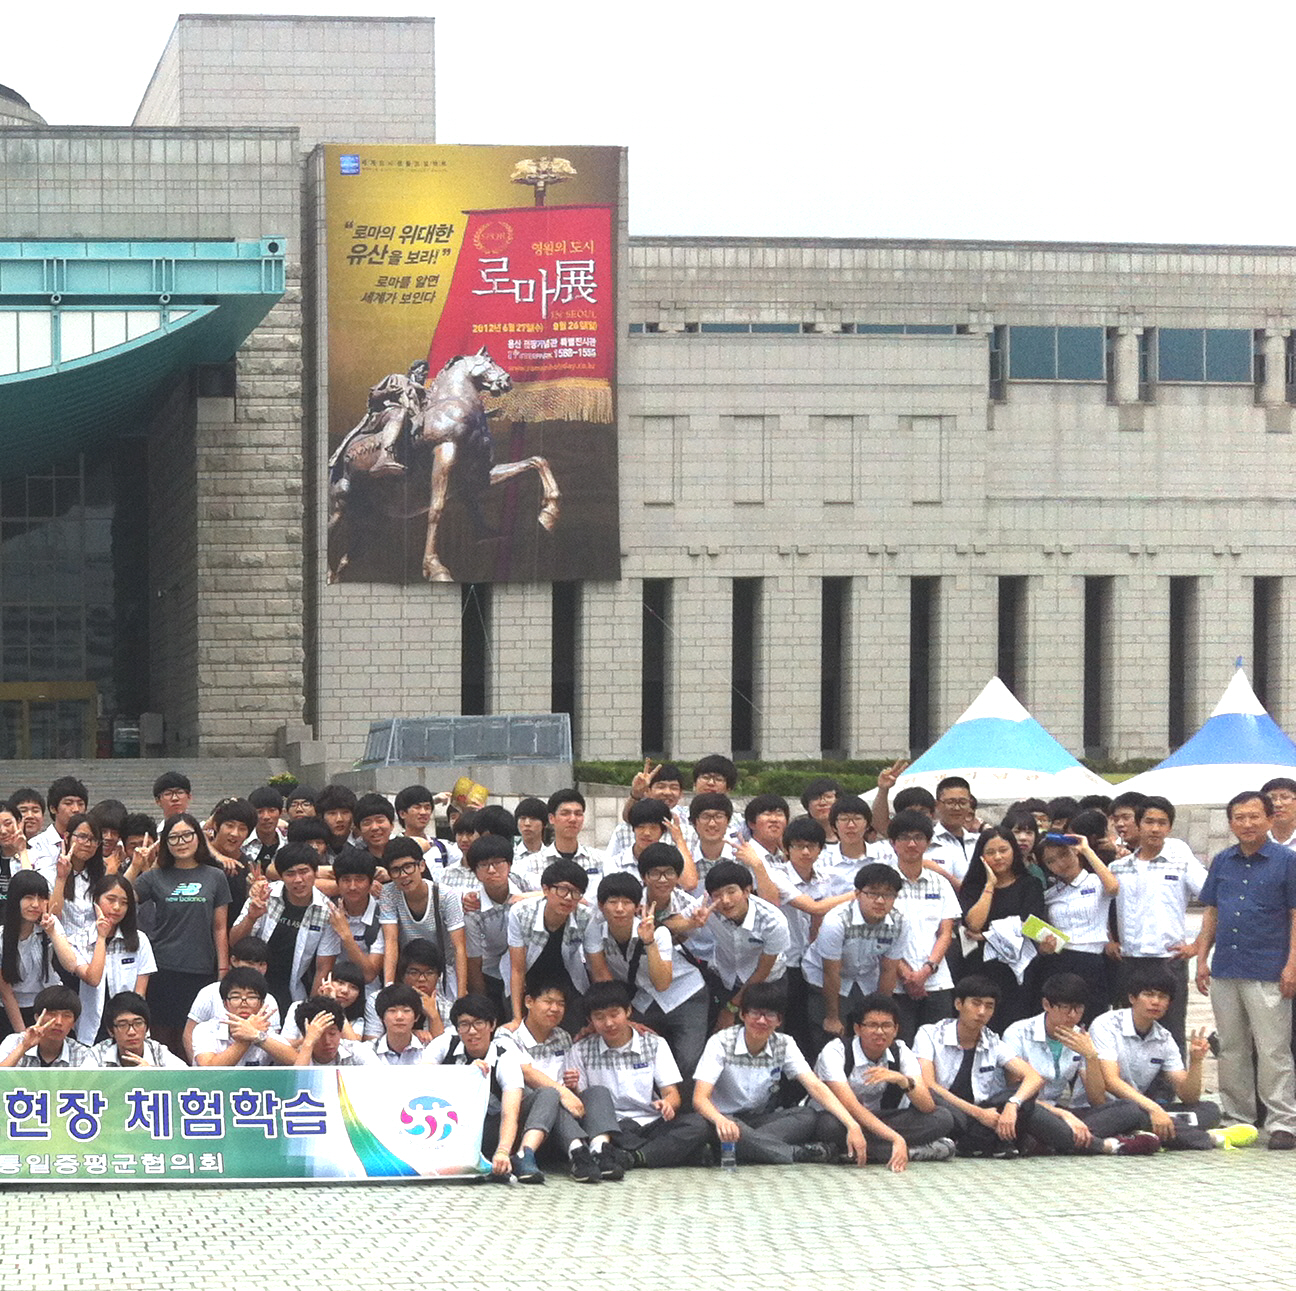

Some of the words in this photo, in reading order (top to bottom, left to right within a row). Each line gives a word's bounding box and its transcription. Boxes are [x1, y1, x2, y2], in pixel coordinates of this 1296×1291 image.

[398, 223, 454, 244] 위대한
[346, 244, 403, 266] 유산을
[569, 240, 594, 254] 도시
[399, 290, 436, 304] 보인다
[472, 257, 598, 320] 로마展
[565, 309, 597, 319] SEOUL
[179, 895, 207, 903] balance
[124, 1087, 329, 1140] 체험학습
